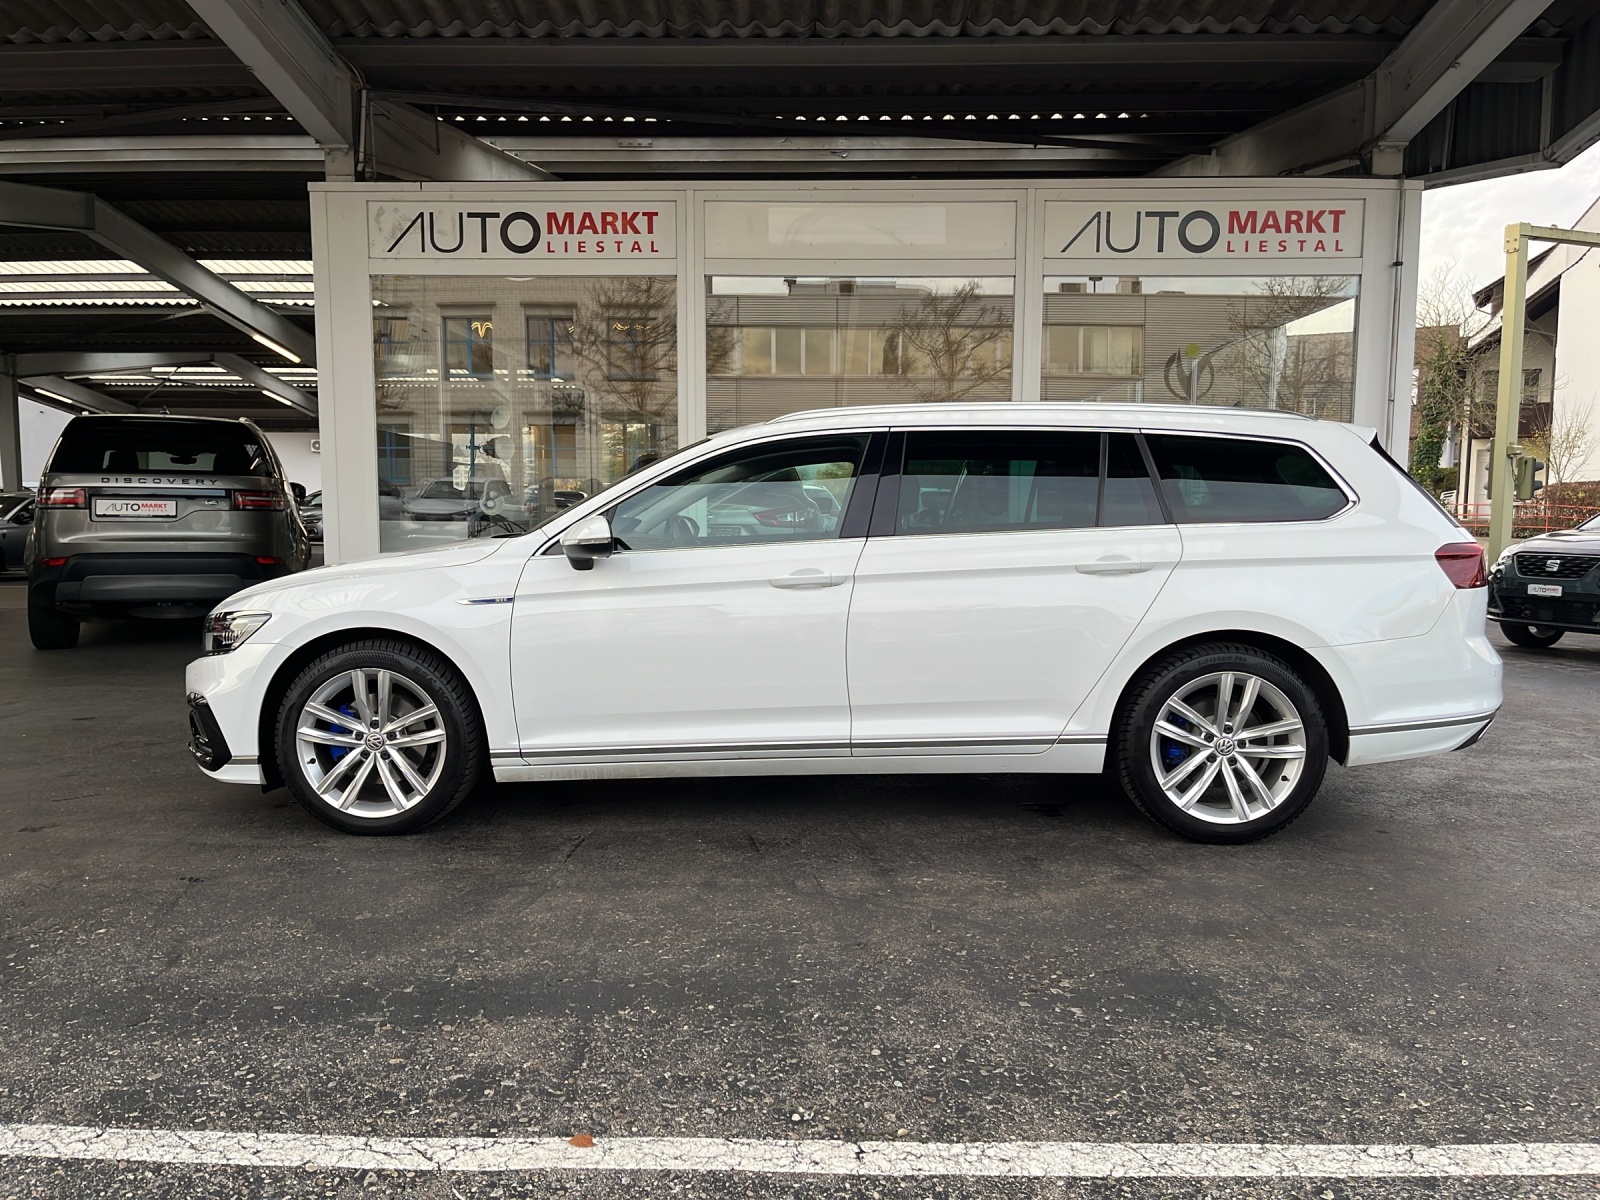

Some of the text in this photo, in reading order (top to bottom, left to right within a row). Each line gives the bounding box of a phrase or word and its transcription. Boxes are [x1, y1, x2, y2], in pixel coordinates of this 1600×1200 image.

[387, 211, 659, 254] AUTO MARKT
[1060, 209, 1346, 254] AUTO MARKT
[546, 241, 659, 253] LIESTAL
[1226, 240, 1344, 253] LIESTAL
[101, 477, 218, 486] DISCOVERY
[105, 503, 140, 512] AUTO
